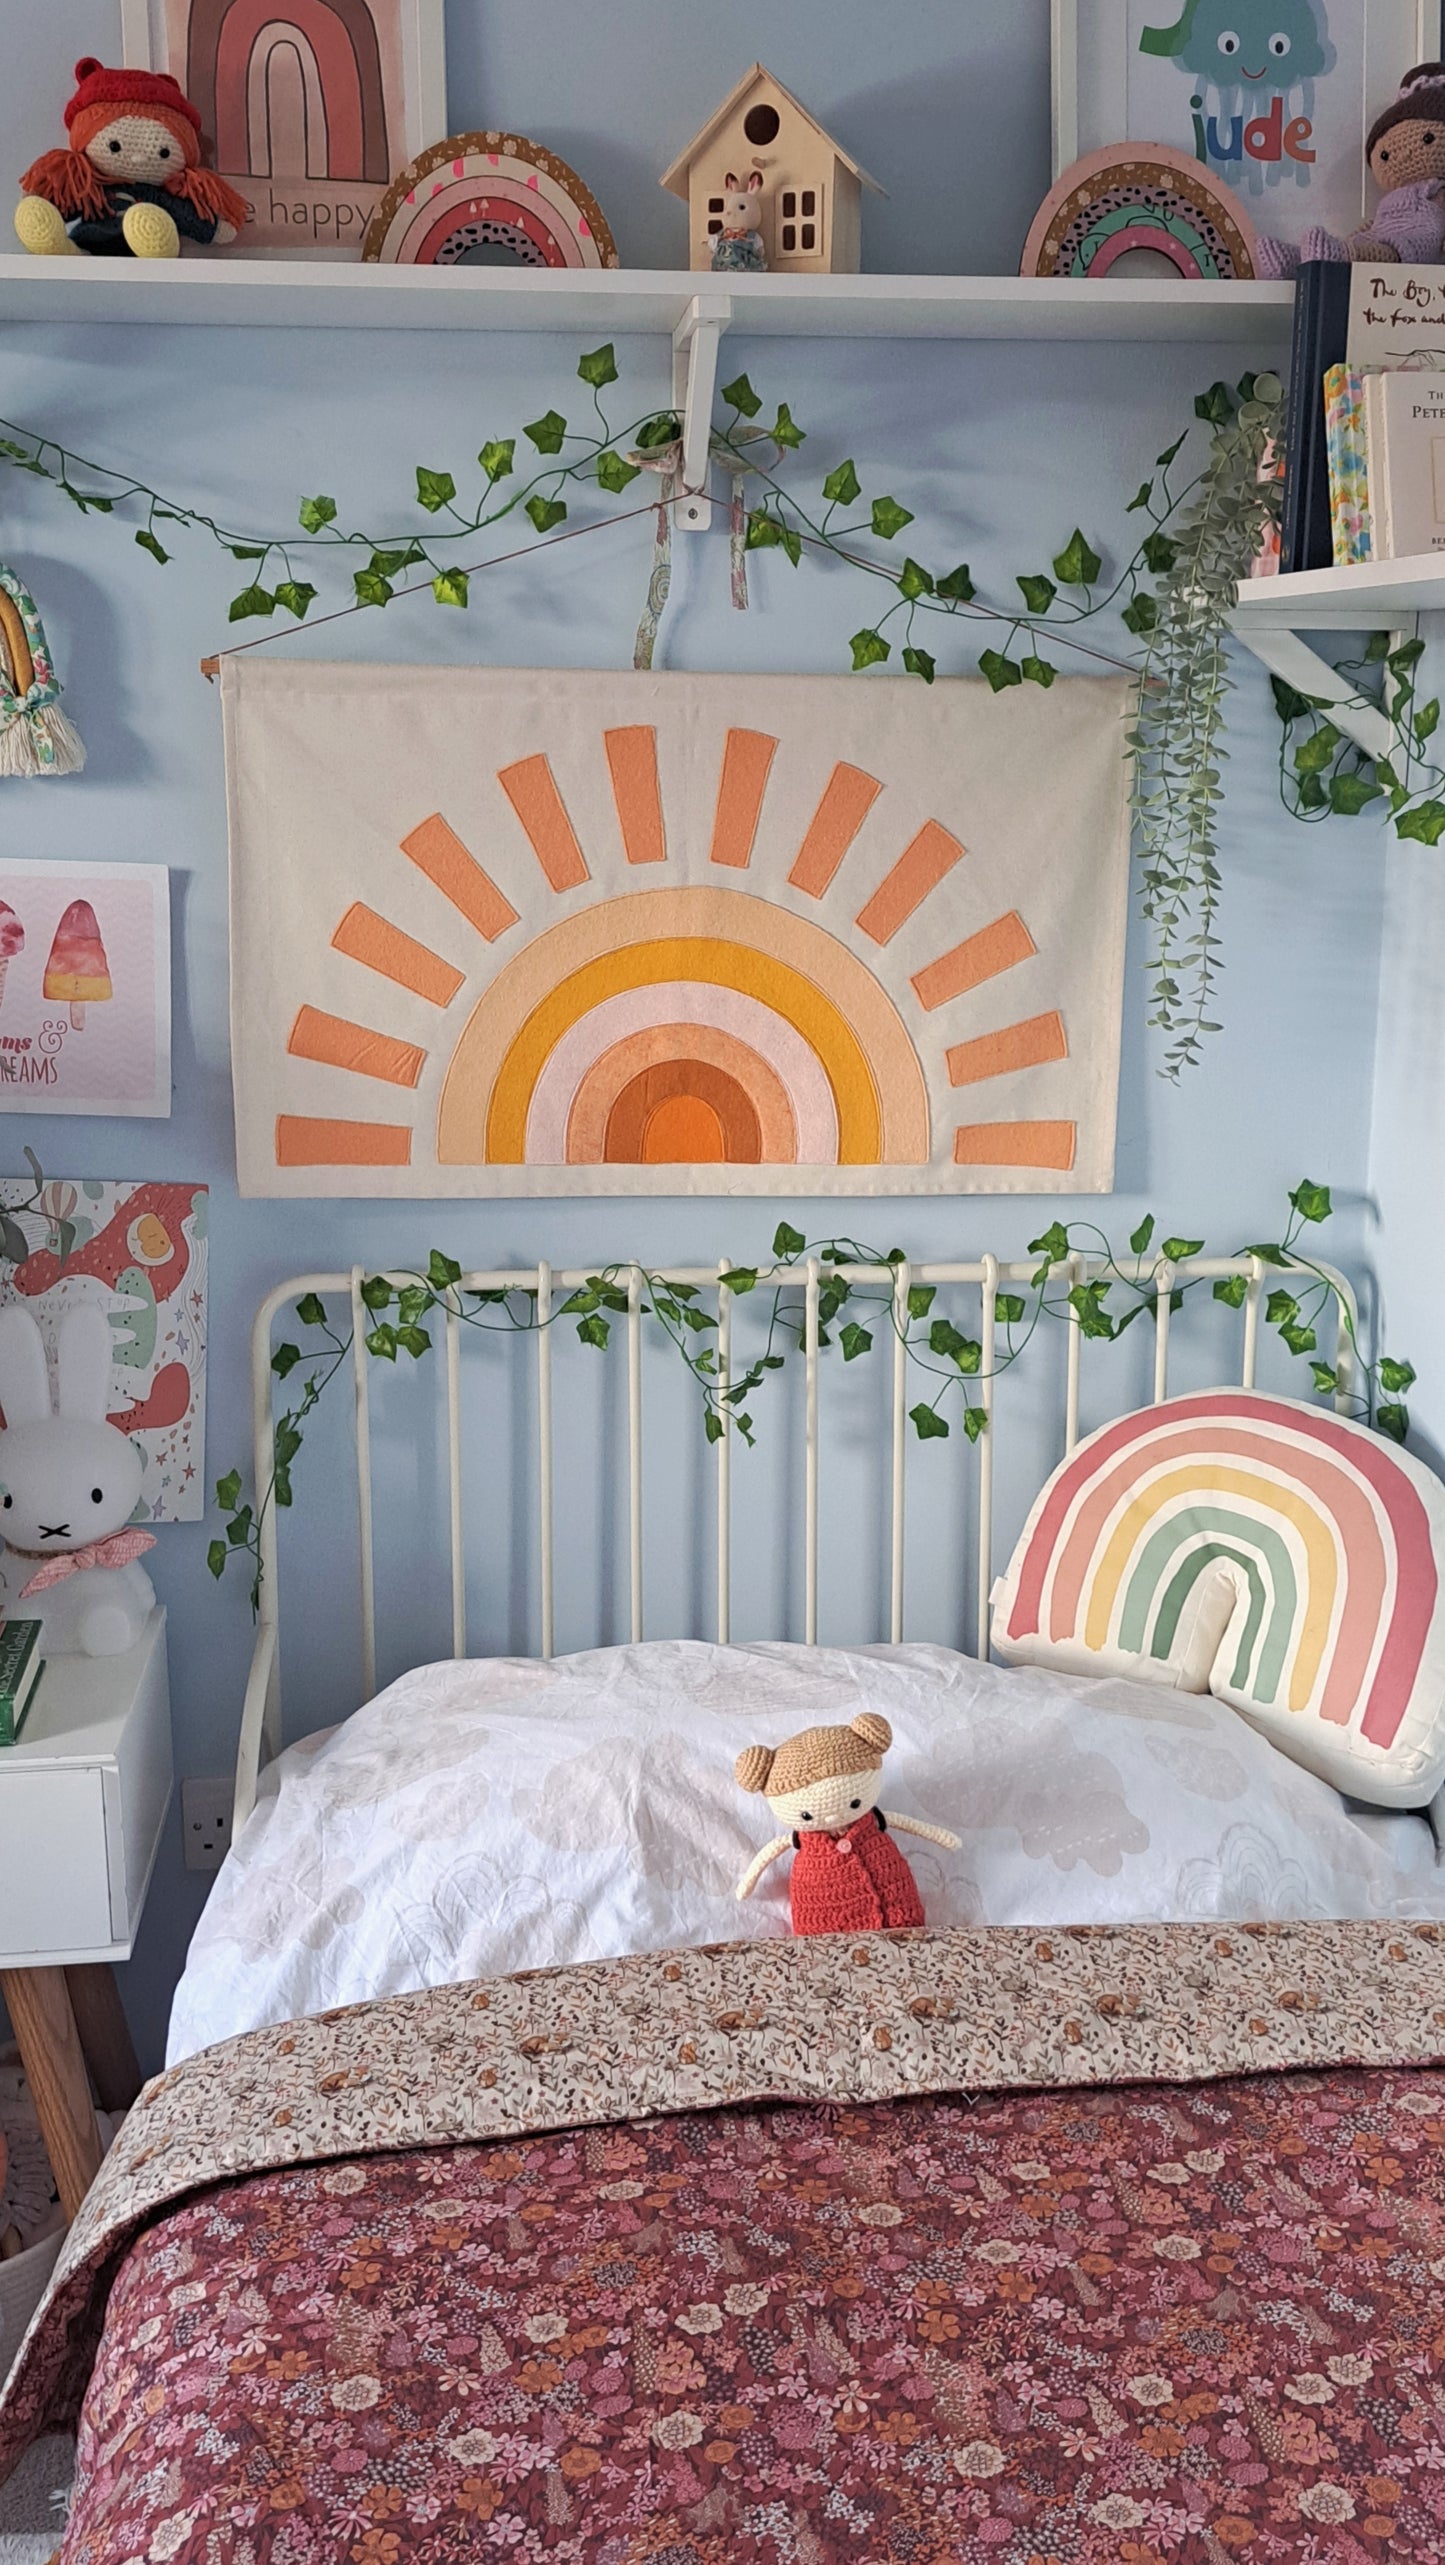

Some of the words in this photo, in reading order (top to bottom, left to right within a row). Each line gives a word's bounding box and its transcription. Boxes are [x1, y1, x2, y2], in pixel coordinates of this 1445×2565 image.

[1189, 94, 1316, 165] jude
[269, 187, 375, 241] happy
[1370, 278, 1397, 299] The
[1362, 307, 1388, 326] the
[0, 1036, 33, 1054] ms
[38, 1020, 68, 1054] &
